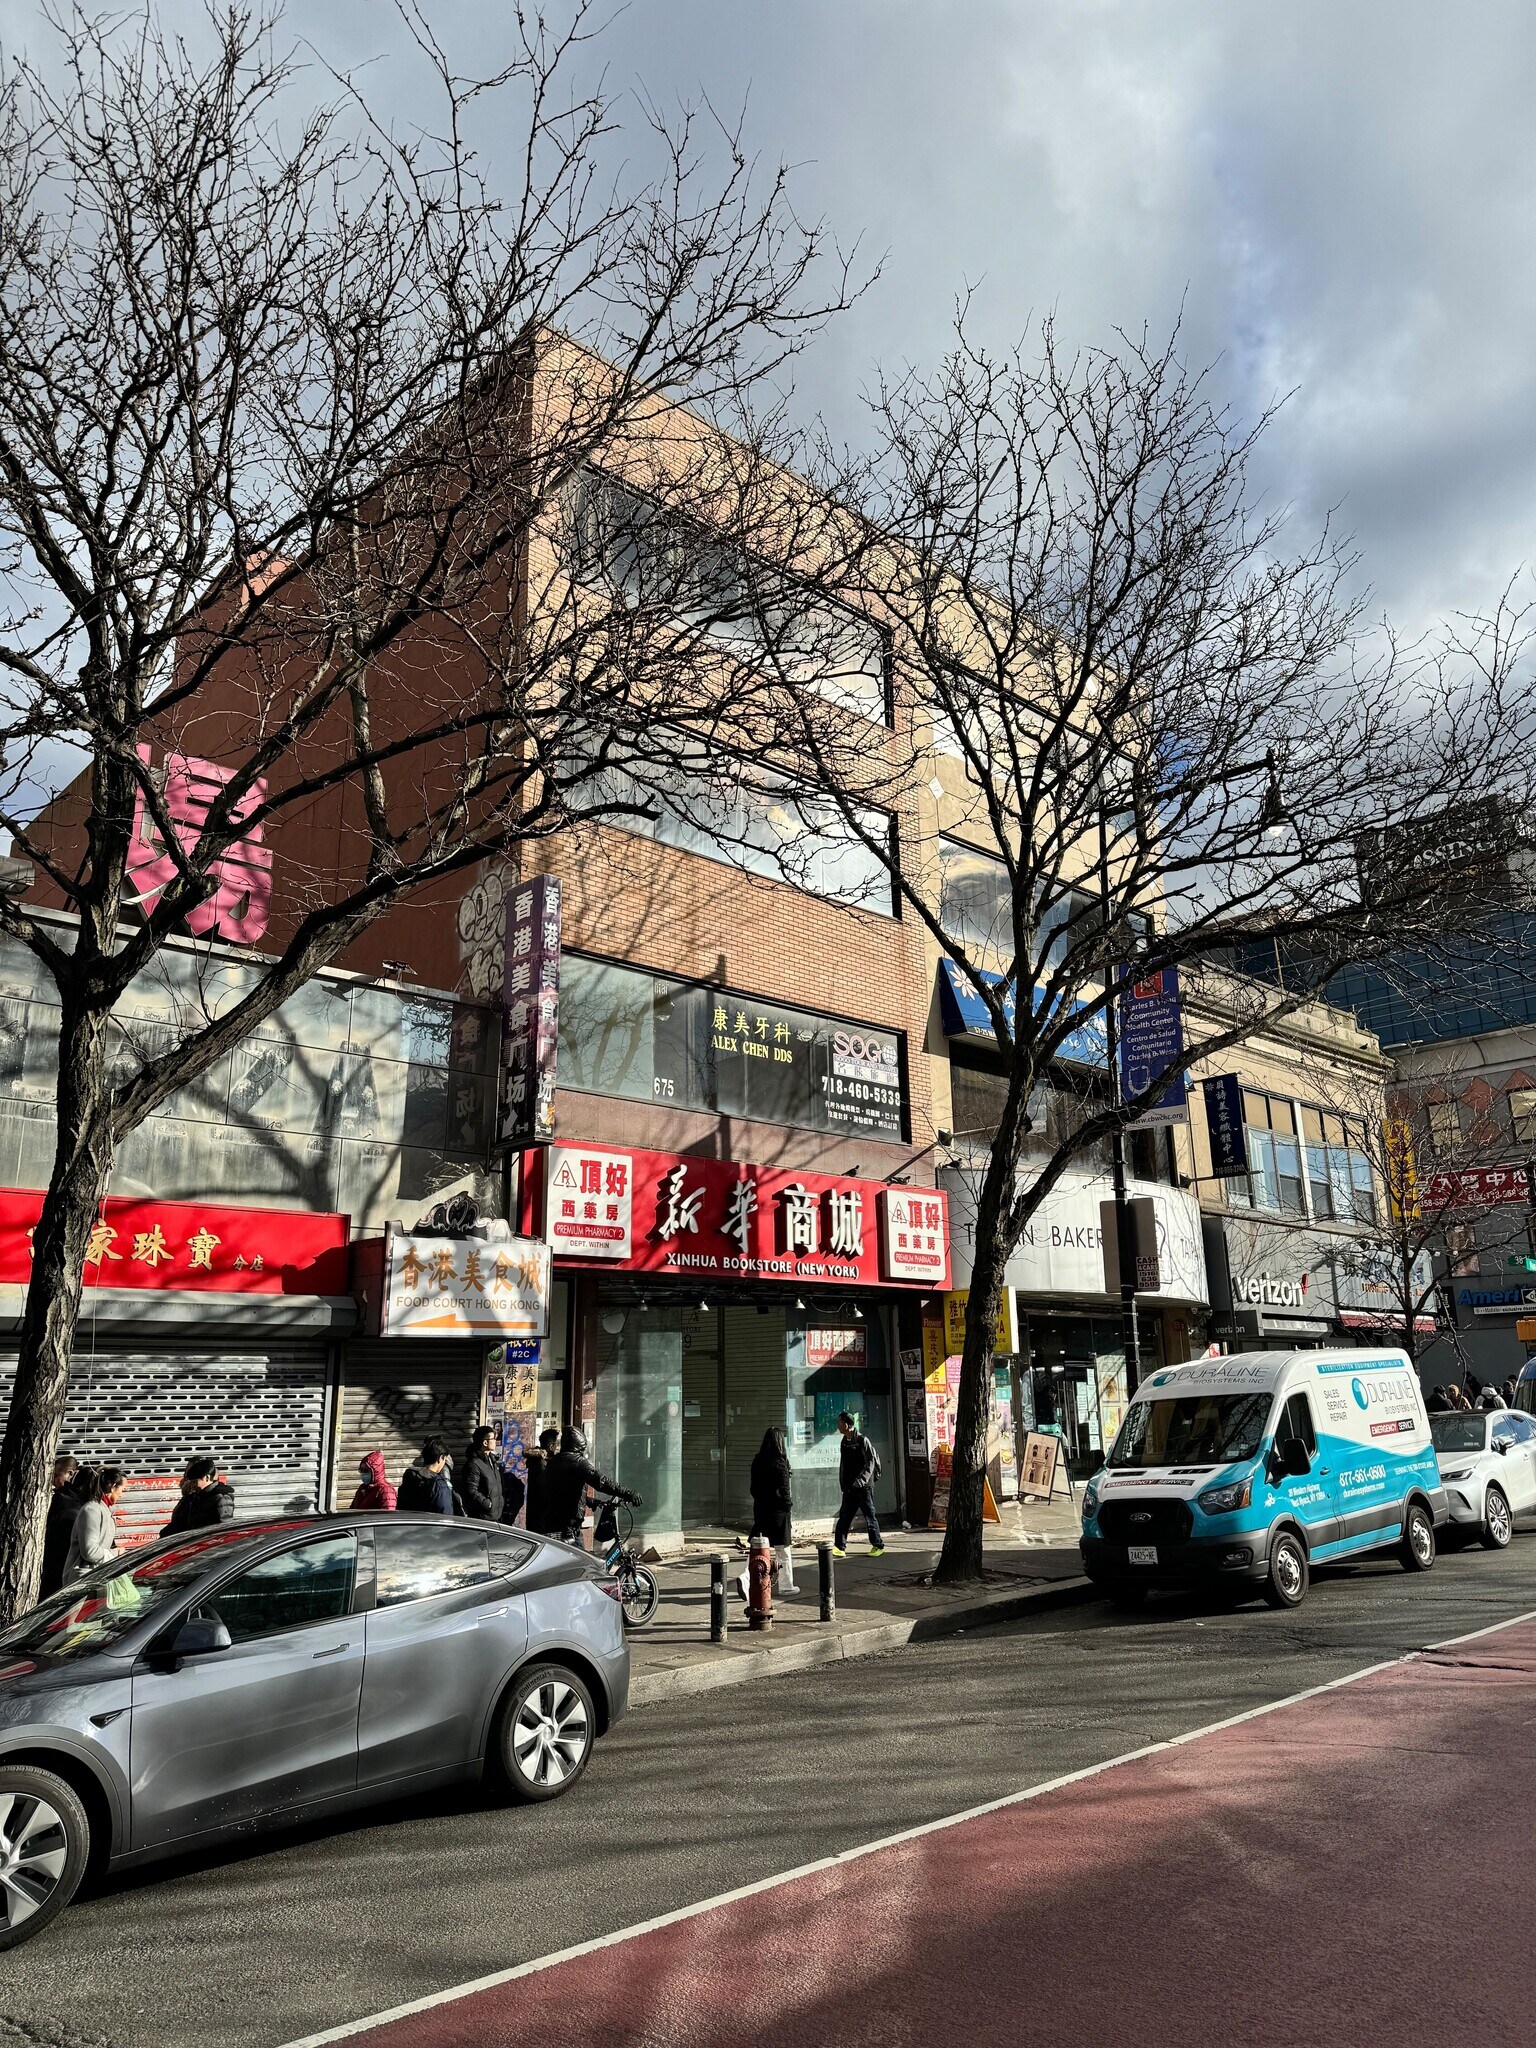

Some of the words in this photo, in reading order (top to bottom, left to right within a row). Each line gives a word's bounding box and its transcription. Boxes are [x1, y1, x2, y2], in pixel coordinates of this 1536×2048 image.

[505, 889, 534, 1104] 香港美食广场
[537, 885, 560, 1102] 香港美食广场
[711, 1005, 792, 1046] 康美牙科
[1126, 1034, 1149, 1044] Centro
[1149, 1032, 1157, 1040] de
[1158, 1028, 1177, 1037] Salud
[711, 1034, 738, 1053] ALEX
[742, 1041, 769, 1059] CHEN
[773, 1048, 793, 1064] DDS
[653, 1076, 675, 1097] 675
[579, 1159, 628, 1198] 頂好
[561, 1198, 620, 1221] 西藥房
[908, 1200, 940, 1231] 頂好
[556, 1225, 584, 1237] PREMIUM
[584, 1226, 617, 1239] PHARMACY
[617, 1229, 624, 1239] 2
[569, 1239, 588, 1248] DEPT.
[588, 1240, 610, 1249] WITHIN
[897, 1232, 936, 1251] 西藥房
[232, 1254, 265, 1272] 分店
[667, 1252, 718, 1268] XINHUA
[723, 1256, 793, 1273] BOOKSTORE
[796, 1263, 826, 1277] (NEW
[827, 1265, 860, 1280] YORK)
[895, 1253, 914, 1263] PREMIUM
[914, 1254, 935, 1264] PHARMACY
[396, 1245, 543, 1295] 香港美食城
[1235, 1272, 1304, 1306] verizon
[396, 1296, 430, 1308] FOOD
[433, 1298, 473, 1309] COURT
[475, 1299, 507, 1310] HONG
[509, 1300, 540, 1311] KONG
[1215, 1325, 1246, 1334] verion
[511, 1350, 530, 1358] #2C
[1178, 1367, 1270, 1381] DURALINE
[1193, 1377, 1246, 1385] BIOSYSTEMS
[505, 1383, 535, 1398] 牙科
[1323, 1388, 1340, 1400] SALES
[1367, 1379, 1414, 1403] DURALINE
[1327, 1399, 1348, 1411] SERVICE
[1384, 1403, 1410, 1415] BIOSYSTEMS
[935, 1395, 947, 1446] 頂好西
[1330, 1411, 1348, 1422] REPAIR
[1371, 1422, 1397, 1435] EMERGENCY
[1398, 1420, 1414, 1431] SERVICE
[1106, 1480, 1156, 1488] EMERGENCY
[1339, 1464, 1387, 1487] 877-561-0500
